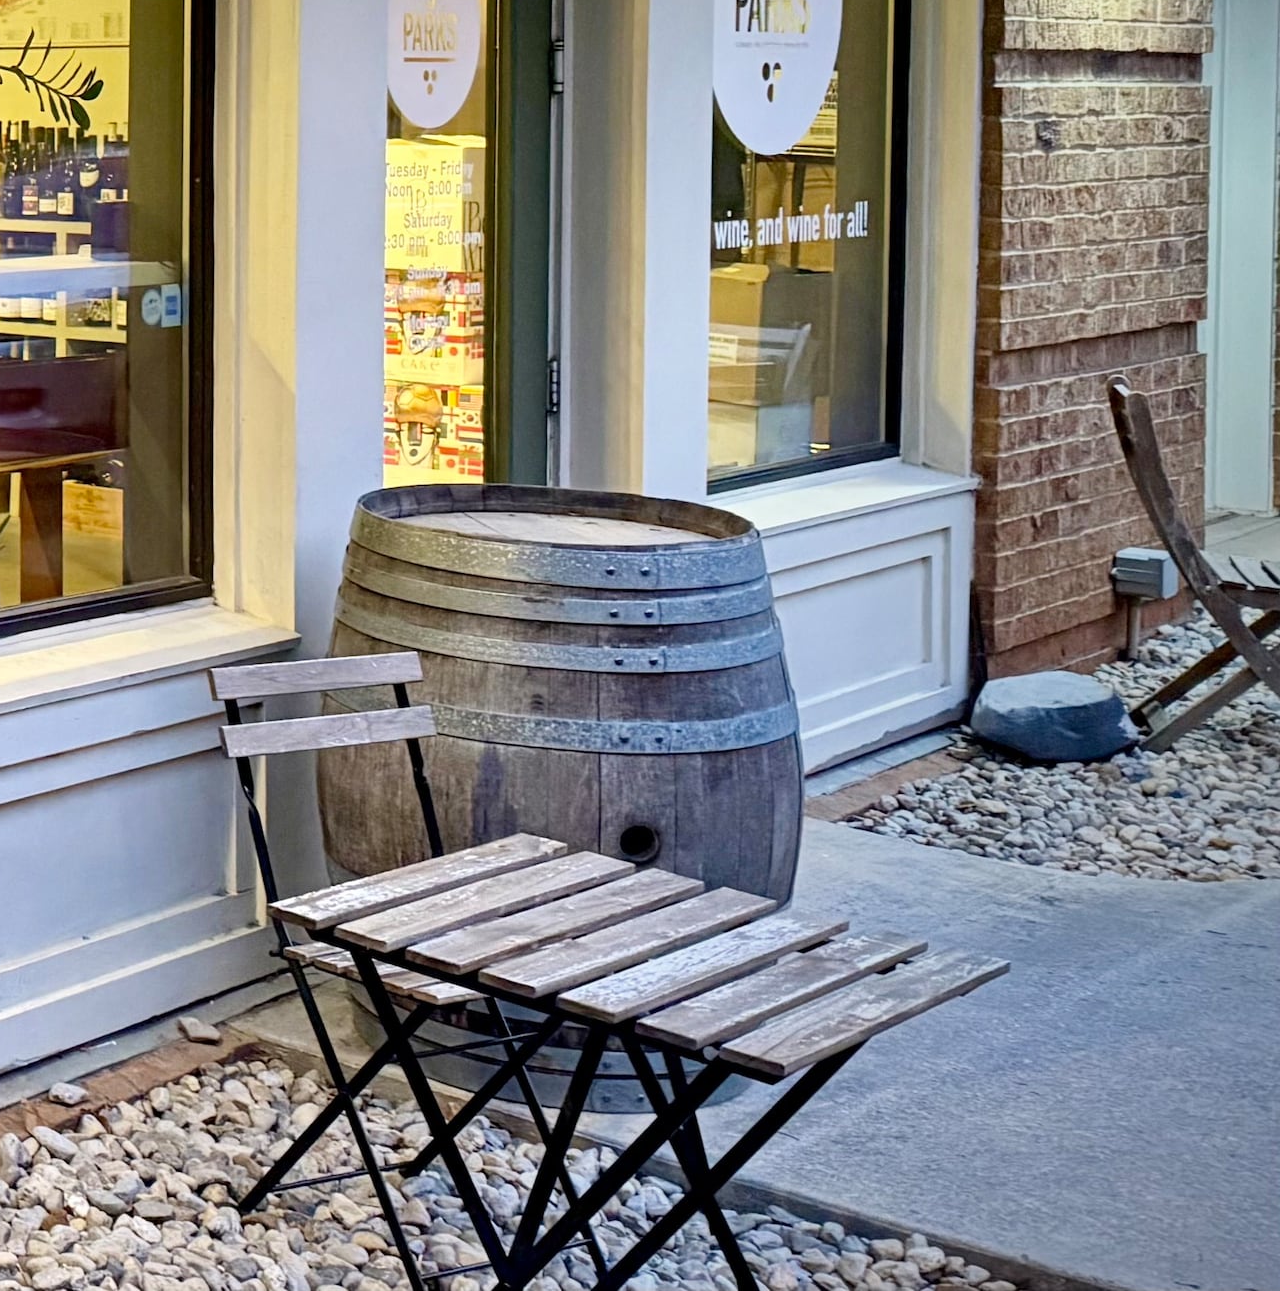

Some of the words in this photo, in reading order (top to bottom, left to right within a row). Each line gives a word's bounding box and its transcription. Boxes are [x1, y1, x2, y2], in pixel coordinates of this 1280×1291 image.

[403, 12, 458, 52] PARKS
[404, 212, 452, 230] Saturday
[714, 210, 753, 249] wine,
[757, 207, 783, 246] and
[787, 205, 820, 243] wine
[824, 203, 844, 240] for
[846, 200, 869, 238] all!
